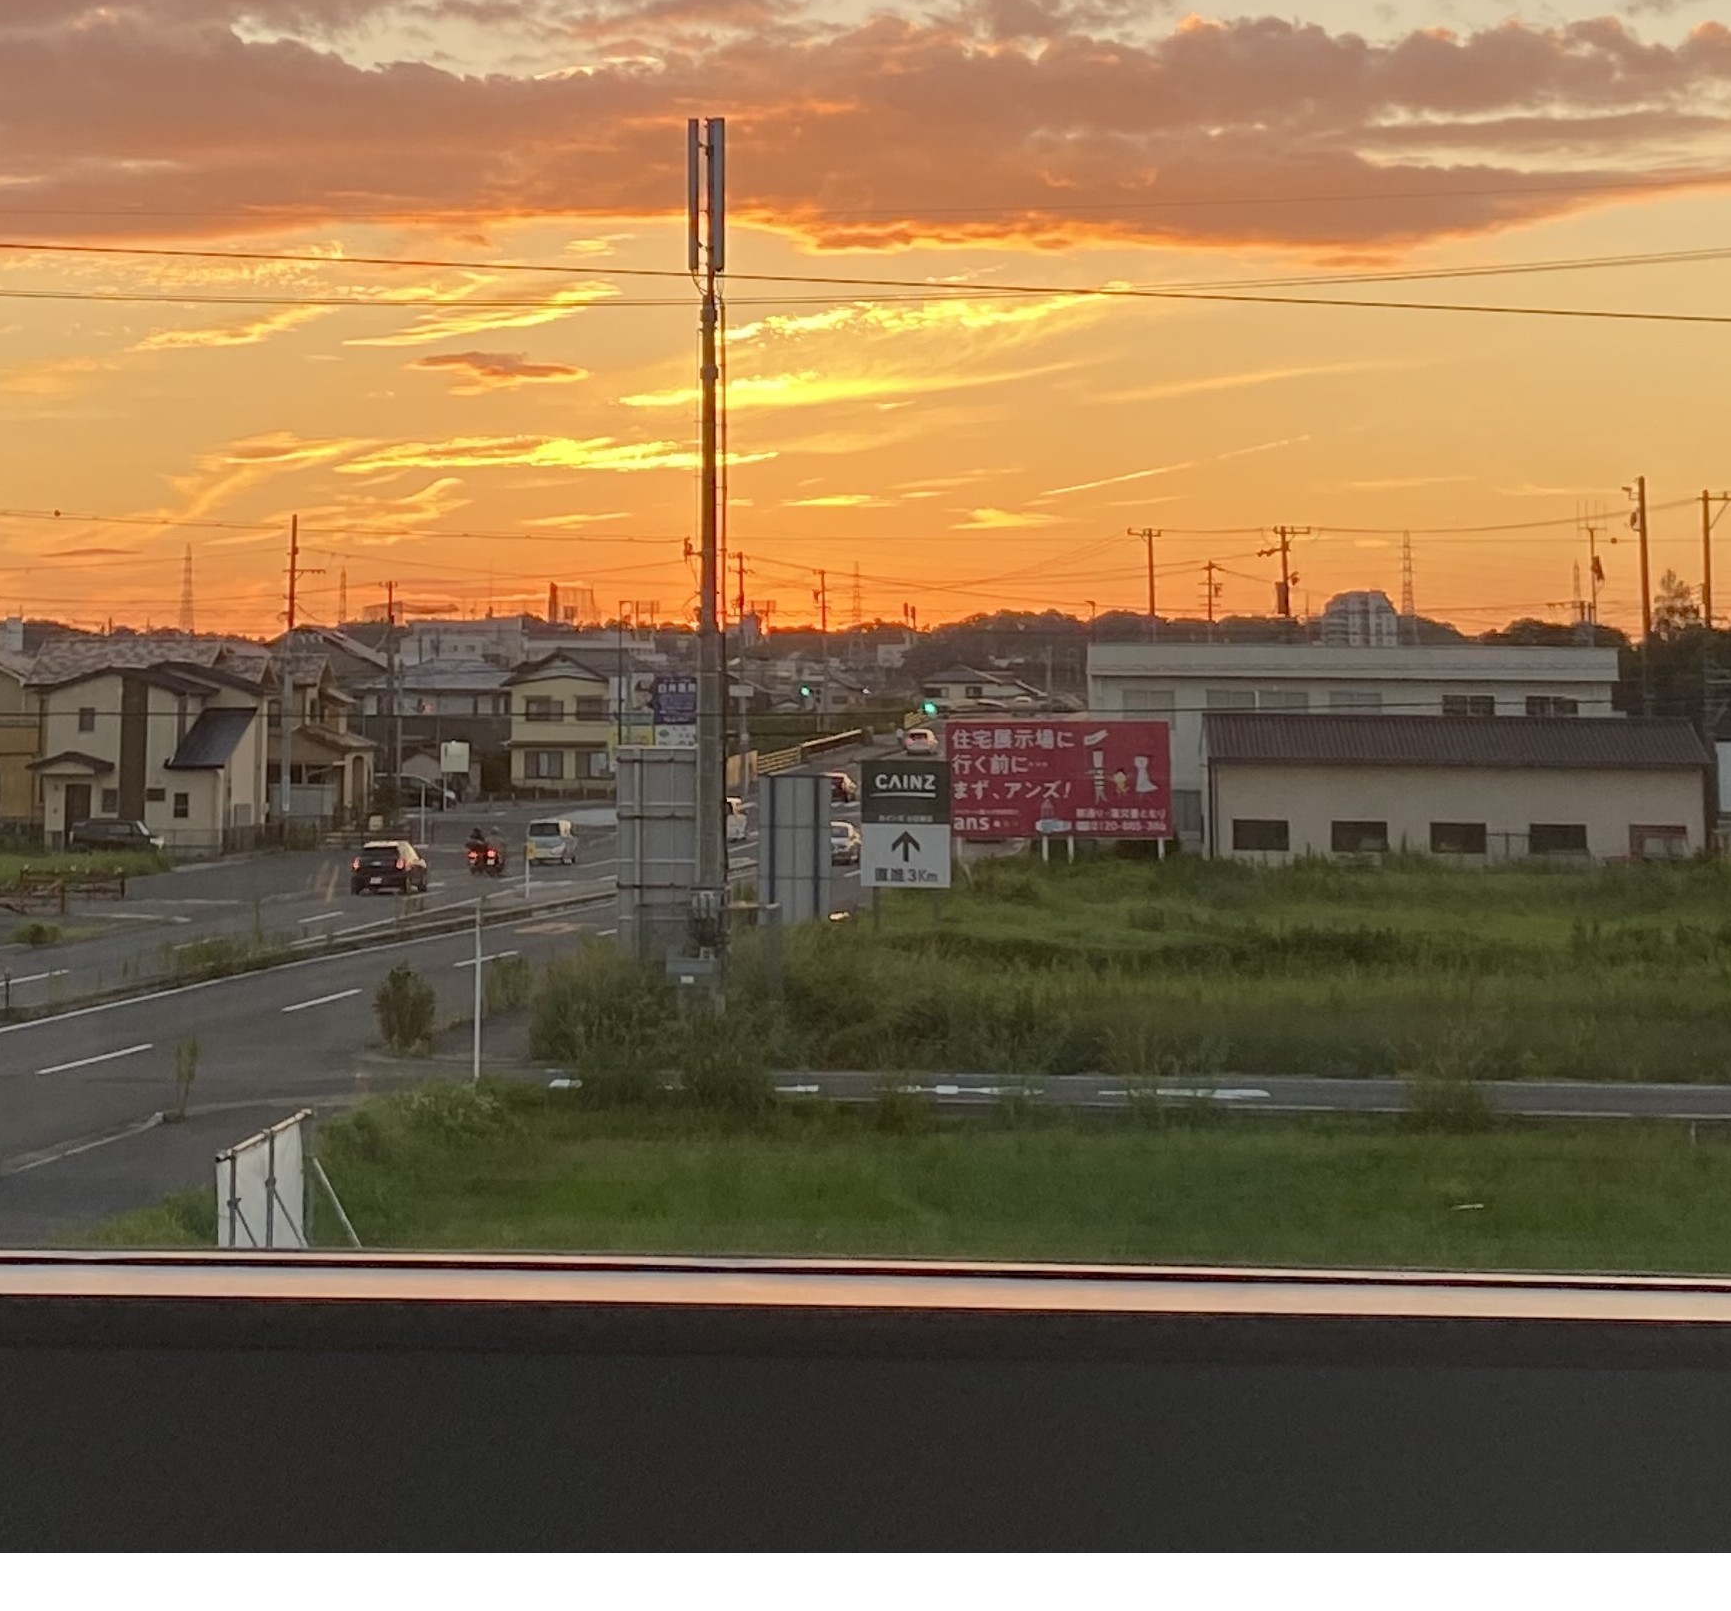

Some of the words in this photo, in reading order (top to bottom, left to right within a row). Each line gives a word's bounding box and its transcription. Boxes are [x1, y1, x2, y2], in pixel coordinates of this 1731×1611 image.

[951, 729, 1074, 749] 住宅展示場に
[874, 774, 936, 790] CAINZ
[953, 817, 990, 831] ans
